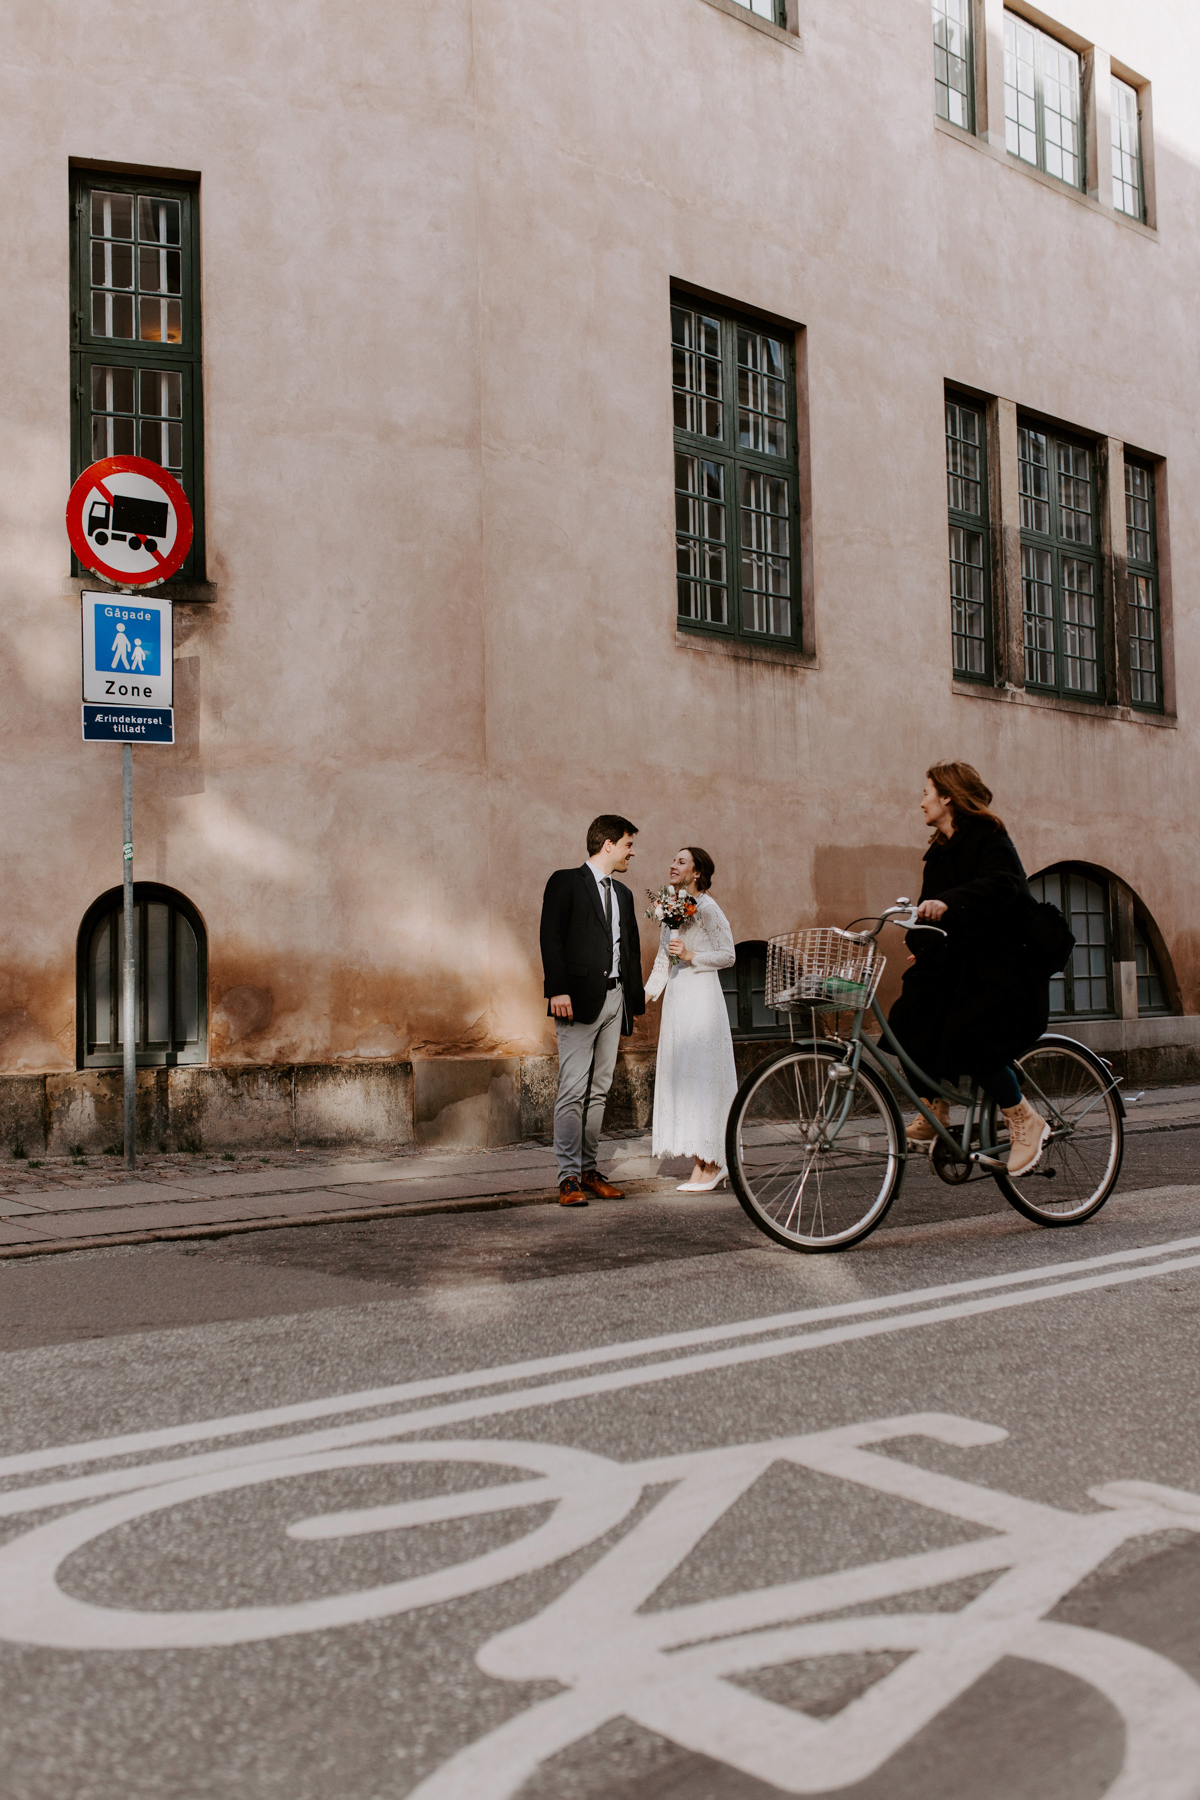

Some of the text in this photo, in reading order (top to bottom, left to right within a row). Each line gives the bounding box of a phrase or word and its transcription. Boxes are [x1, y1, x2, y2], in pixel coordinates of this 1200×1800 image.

[104, 607, 151, 621] Gågade
[105, 680, 152, 698] Zone
[94, 714, 163, 725] Ærindekørsel
[113, 724, 146, 733] tilladt
